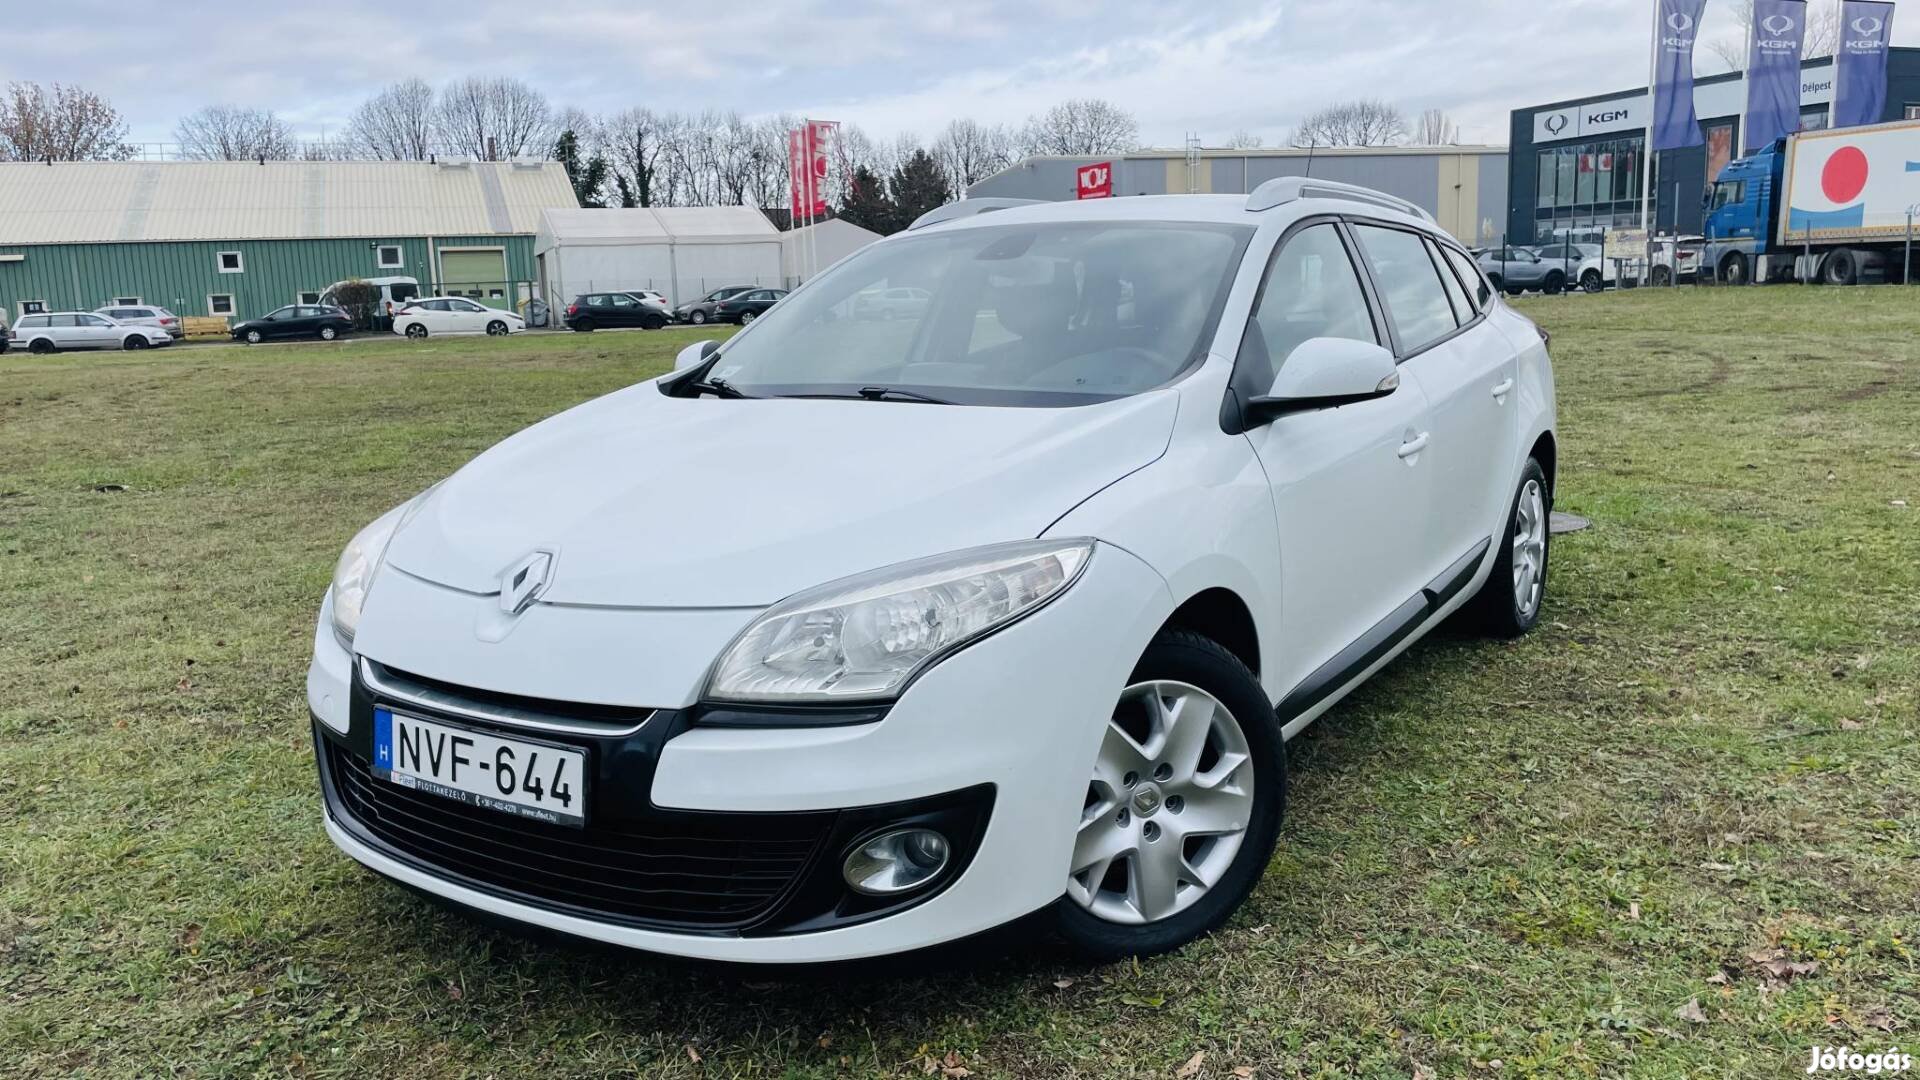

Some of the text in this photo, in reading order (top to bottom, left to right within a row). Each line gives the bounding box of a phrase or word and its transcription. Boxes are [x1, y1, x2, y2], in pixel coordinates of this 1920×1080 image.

[1757, 39, 1797, 49] KGM
[1588, 109, 1628, 125] KGM
[1080, 167, 1108, 189] WOLF
[379, 744, 389, 761] H
[399, 722, 572, 808] NVF-644
